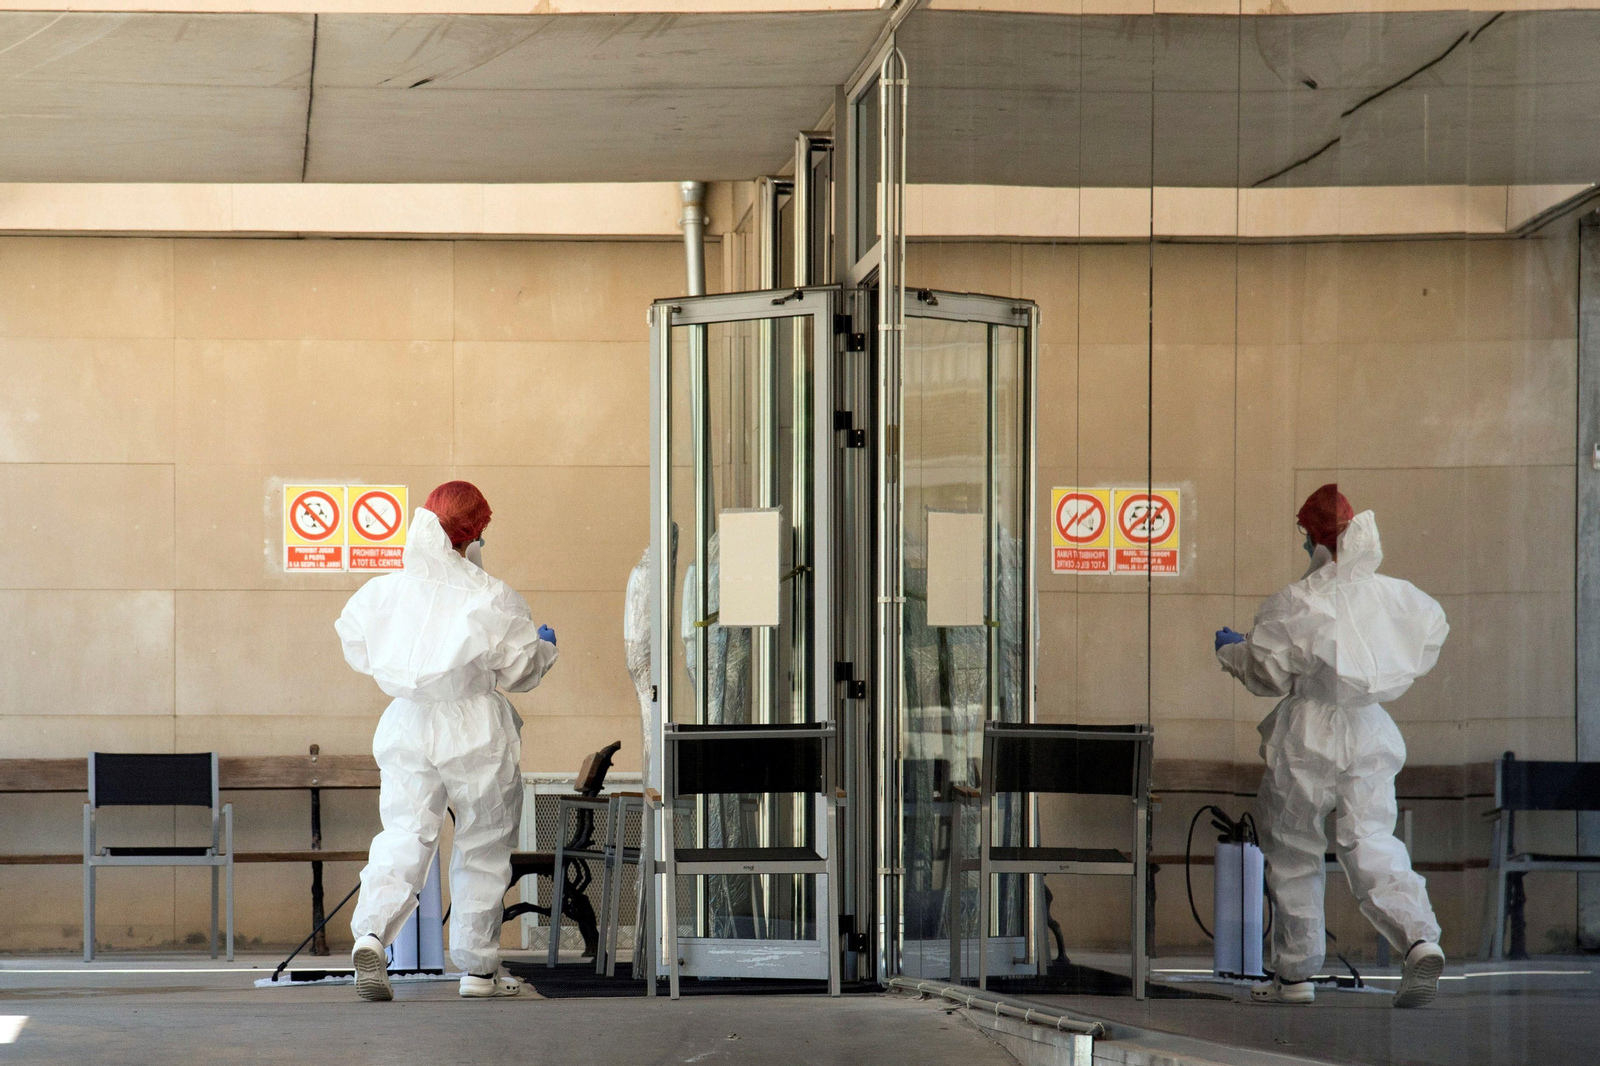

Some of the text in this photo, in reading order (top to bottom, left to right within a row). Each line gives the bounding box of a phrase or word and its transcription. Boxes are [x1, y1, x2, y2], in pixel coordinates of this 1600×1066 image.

[380, 549, 402, 557] FUMAR
[352, 558, 402, 567] A TOT EL CENTRE
